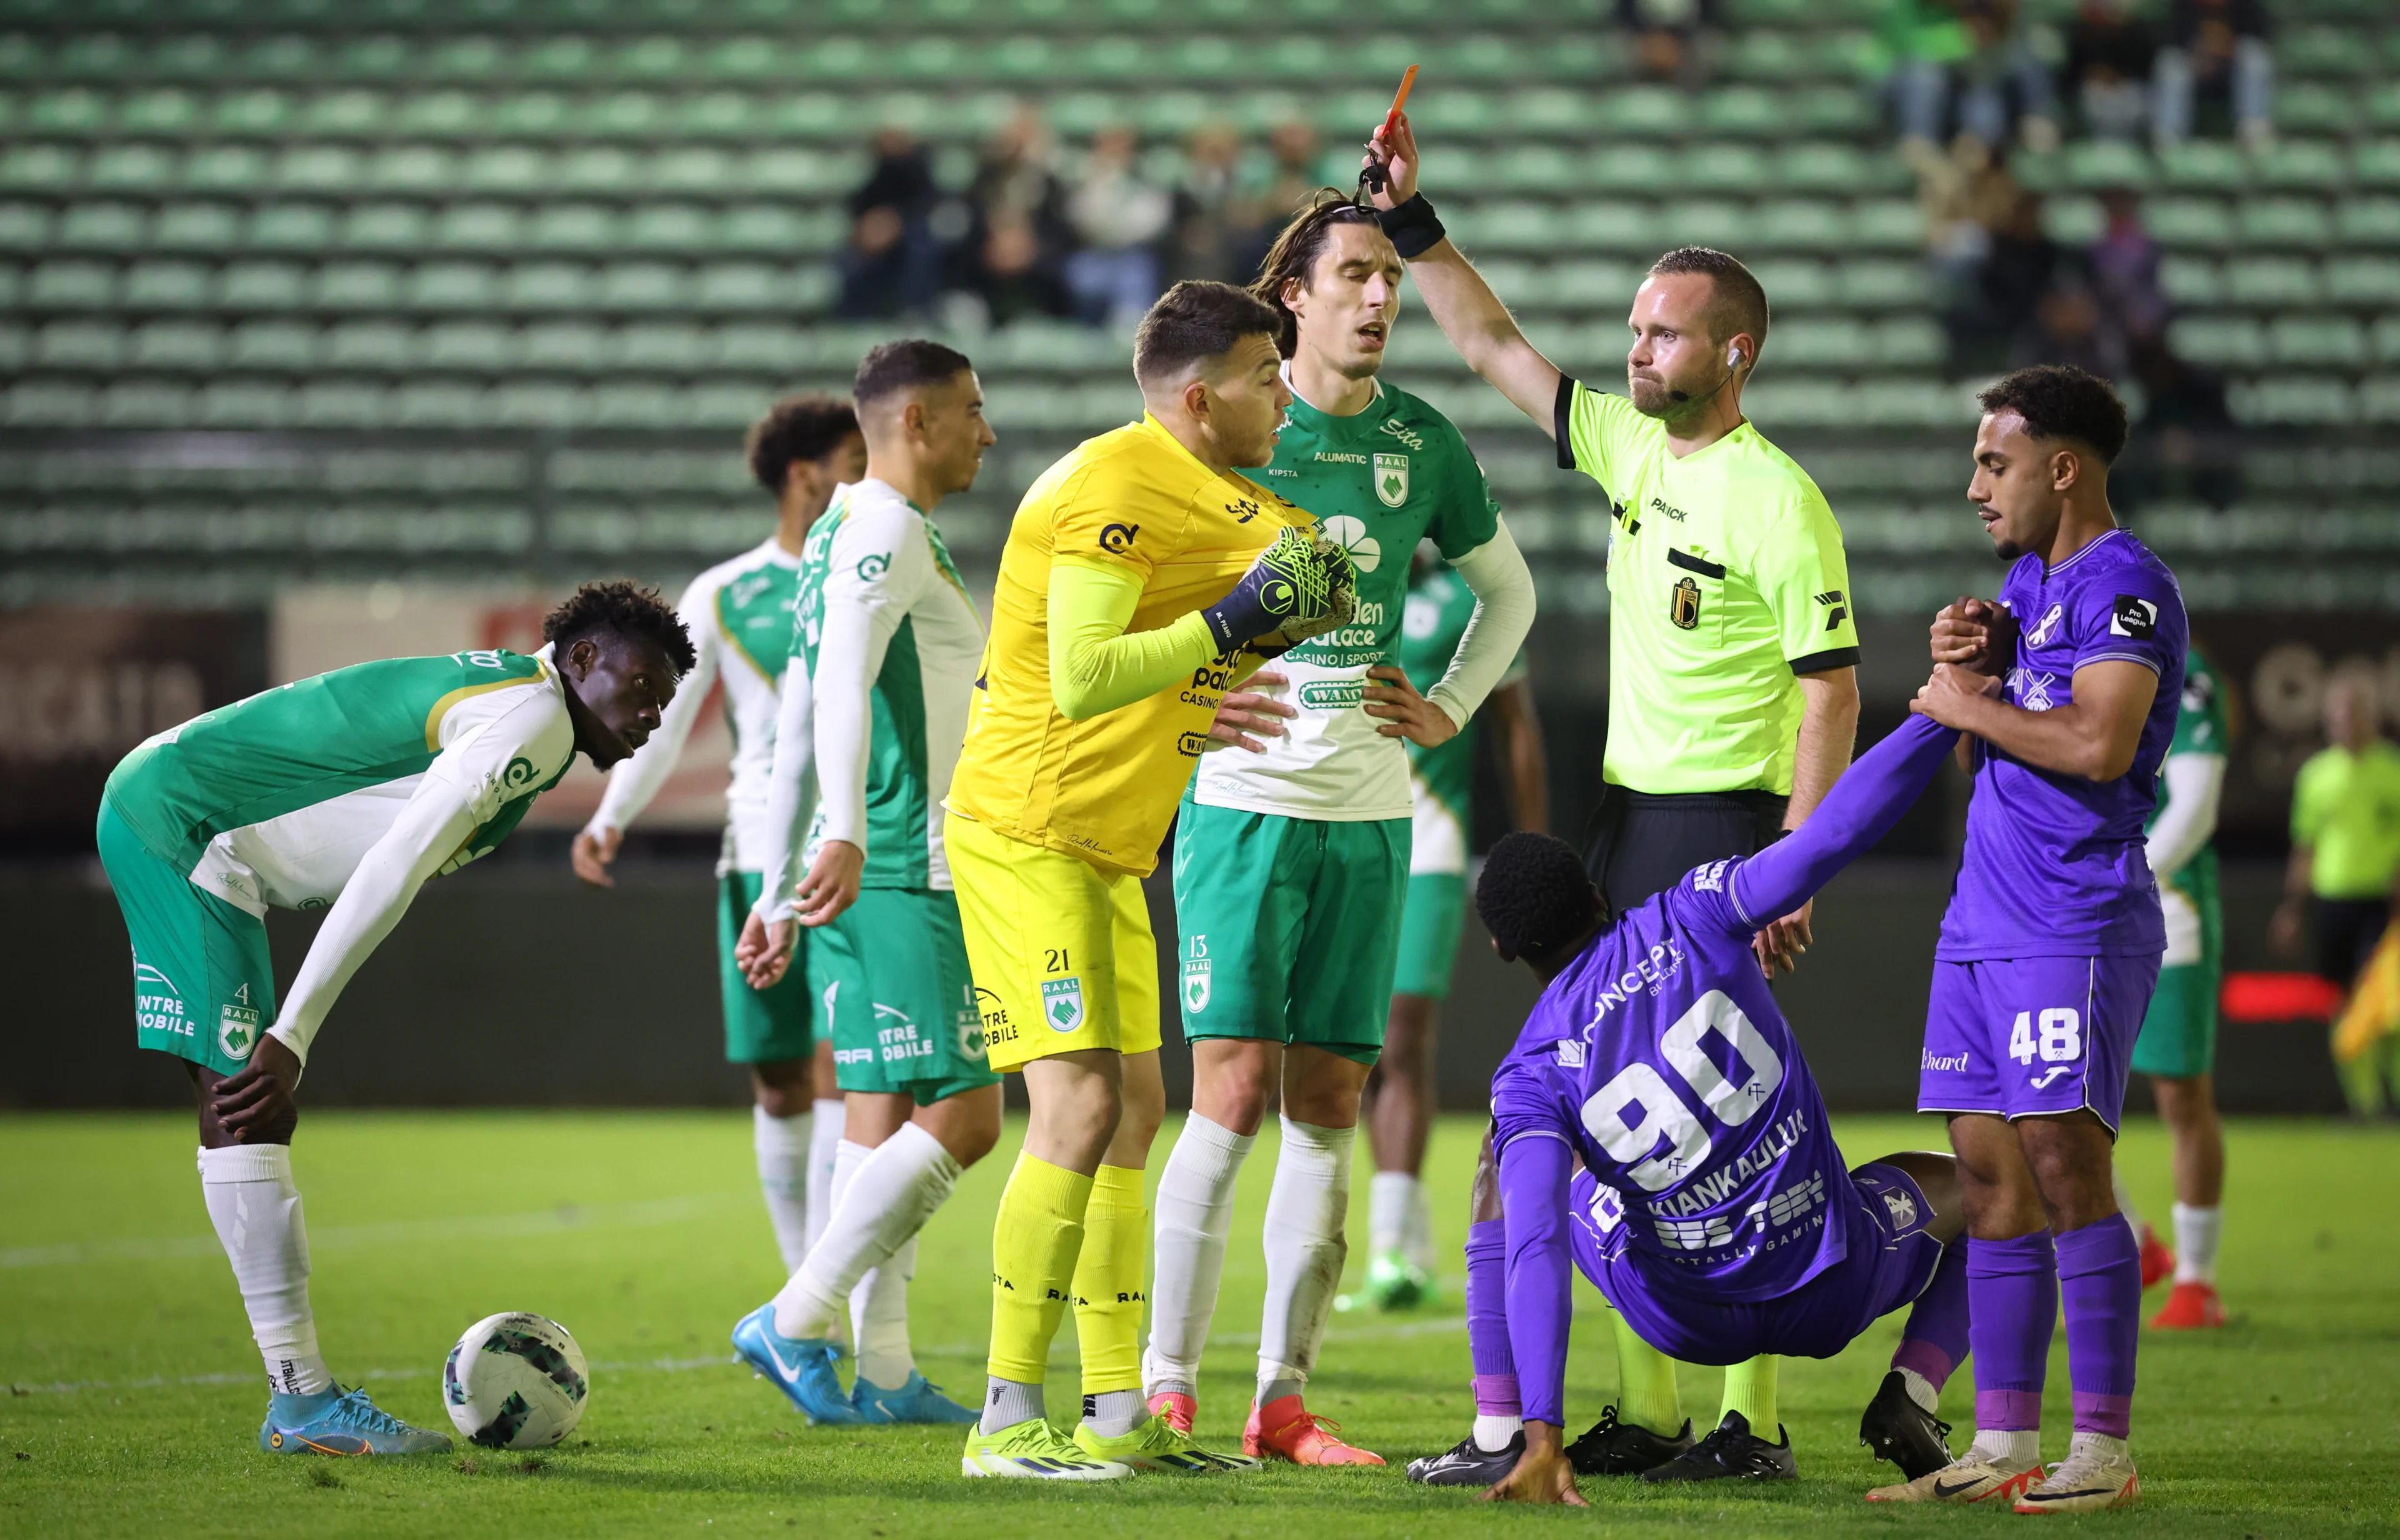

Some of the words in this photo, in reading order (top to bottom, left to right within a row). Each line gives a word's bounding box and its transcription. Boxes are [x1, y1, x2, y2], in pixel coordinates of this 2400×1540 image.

[1379, 418, 1424, 451] Sita
[1314, 451, 1368, 465] ALUMATIC
[1376, 456, 1406, 467] RAAL
[1269, 468, 1298, 478] KIPSTA
[1350, 596, 1383, 625] den
[2120, 614, 2147, 628] League
[2129, 608, 2142, 618] Pro
[1215, 611, 1223, 621] M.
[1219, 619, 1232, 638] PEANO
[1284, 649, 1338, 666] CASINO
[1346, 651, 1386, 666] SPORT
[1190, 934, 1208, 958] 13
[1044, 948, 1069, 973] 21
[1186, 962, 1209, 973] RAAL
[234, 982, 249, 1005] 4
[1042, 979, 1078, 994] RAAL
[138, 995, 184, 1016] NTRE
[224, 1007, 256, 1021] RAAL
[980, 1009, 1008, 1030] TRE
[984, 1024, 1019, 1048] OBILE
[2009, 1008, 2081, 1066] 48
[881, 1039, 934, 1062] OBILE
[1921, 1046, 1968, 1072] hard
[1580, 989, 1783, 1191] 90
[1659, 1244, 1758, 1266] OTALLY
[1766, 1214, 1824, 1251] GAMIN
[1118, 1291, 1146, 1304] RA
